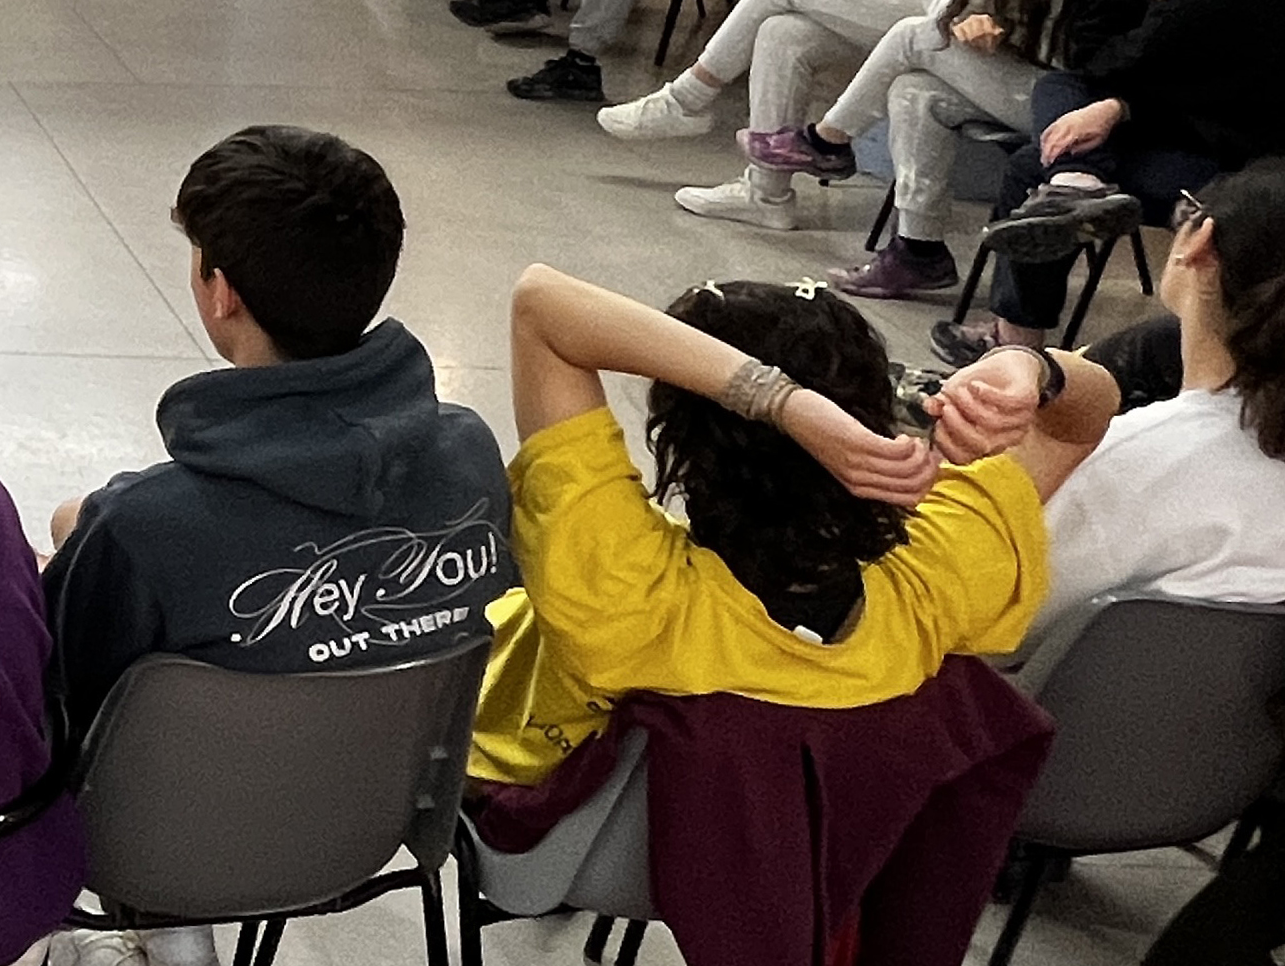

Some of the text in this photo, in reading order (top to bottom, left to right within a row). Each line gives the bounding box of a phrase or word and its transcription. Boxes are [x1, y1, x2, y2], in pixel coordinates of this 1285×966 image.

[229, 530, 499, 646] Hey You!
[308, 632, 370, 663] OUT
